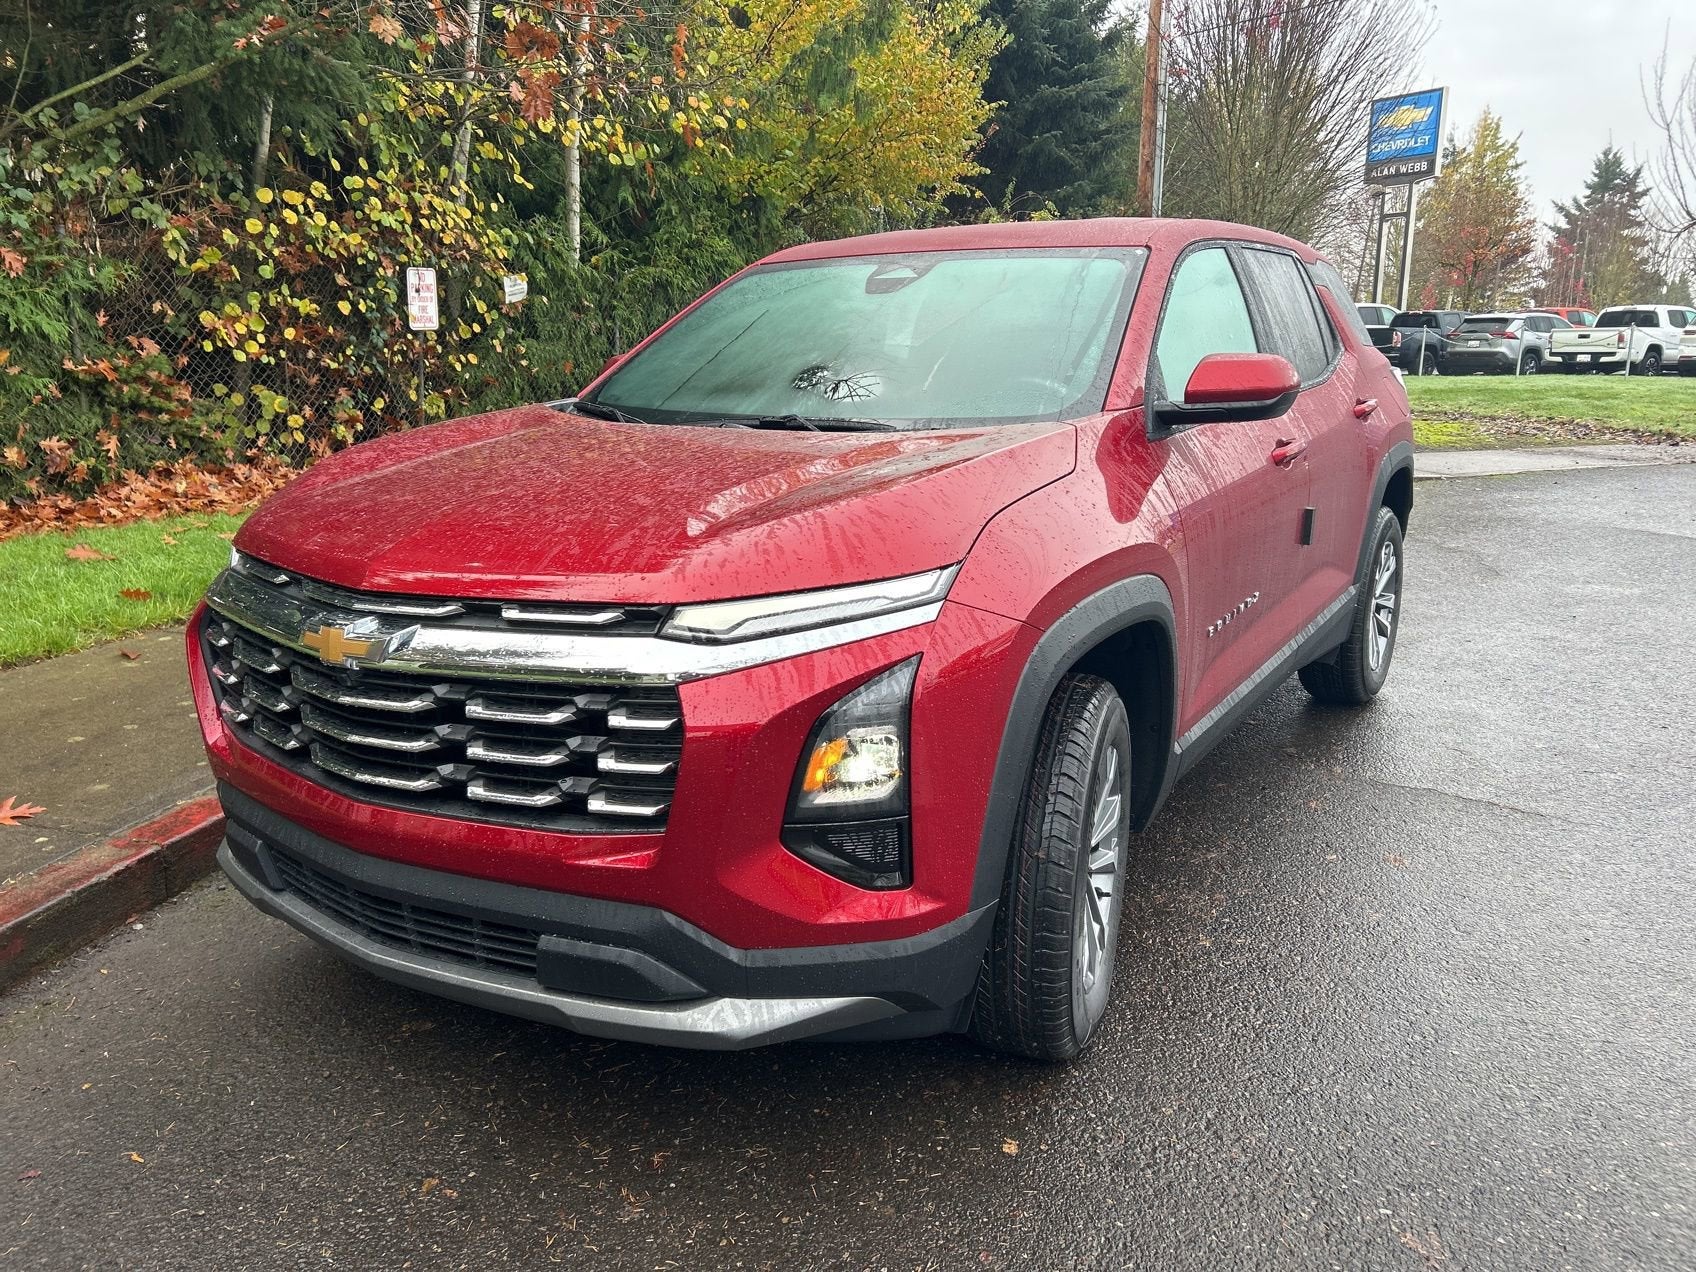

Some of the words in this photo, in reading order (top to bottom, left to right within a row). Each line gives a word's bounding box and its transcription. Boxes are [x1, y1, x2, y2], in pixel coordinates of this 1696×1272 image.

[1372, 135, 1431, 153] CHEVROLET
[1371, 165, 1396, 178] ALAN
[1400, 161, 1428, 174] WEBB
[1207, 591, 1260, 638] EQUINOX
